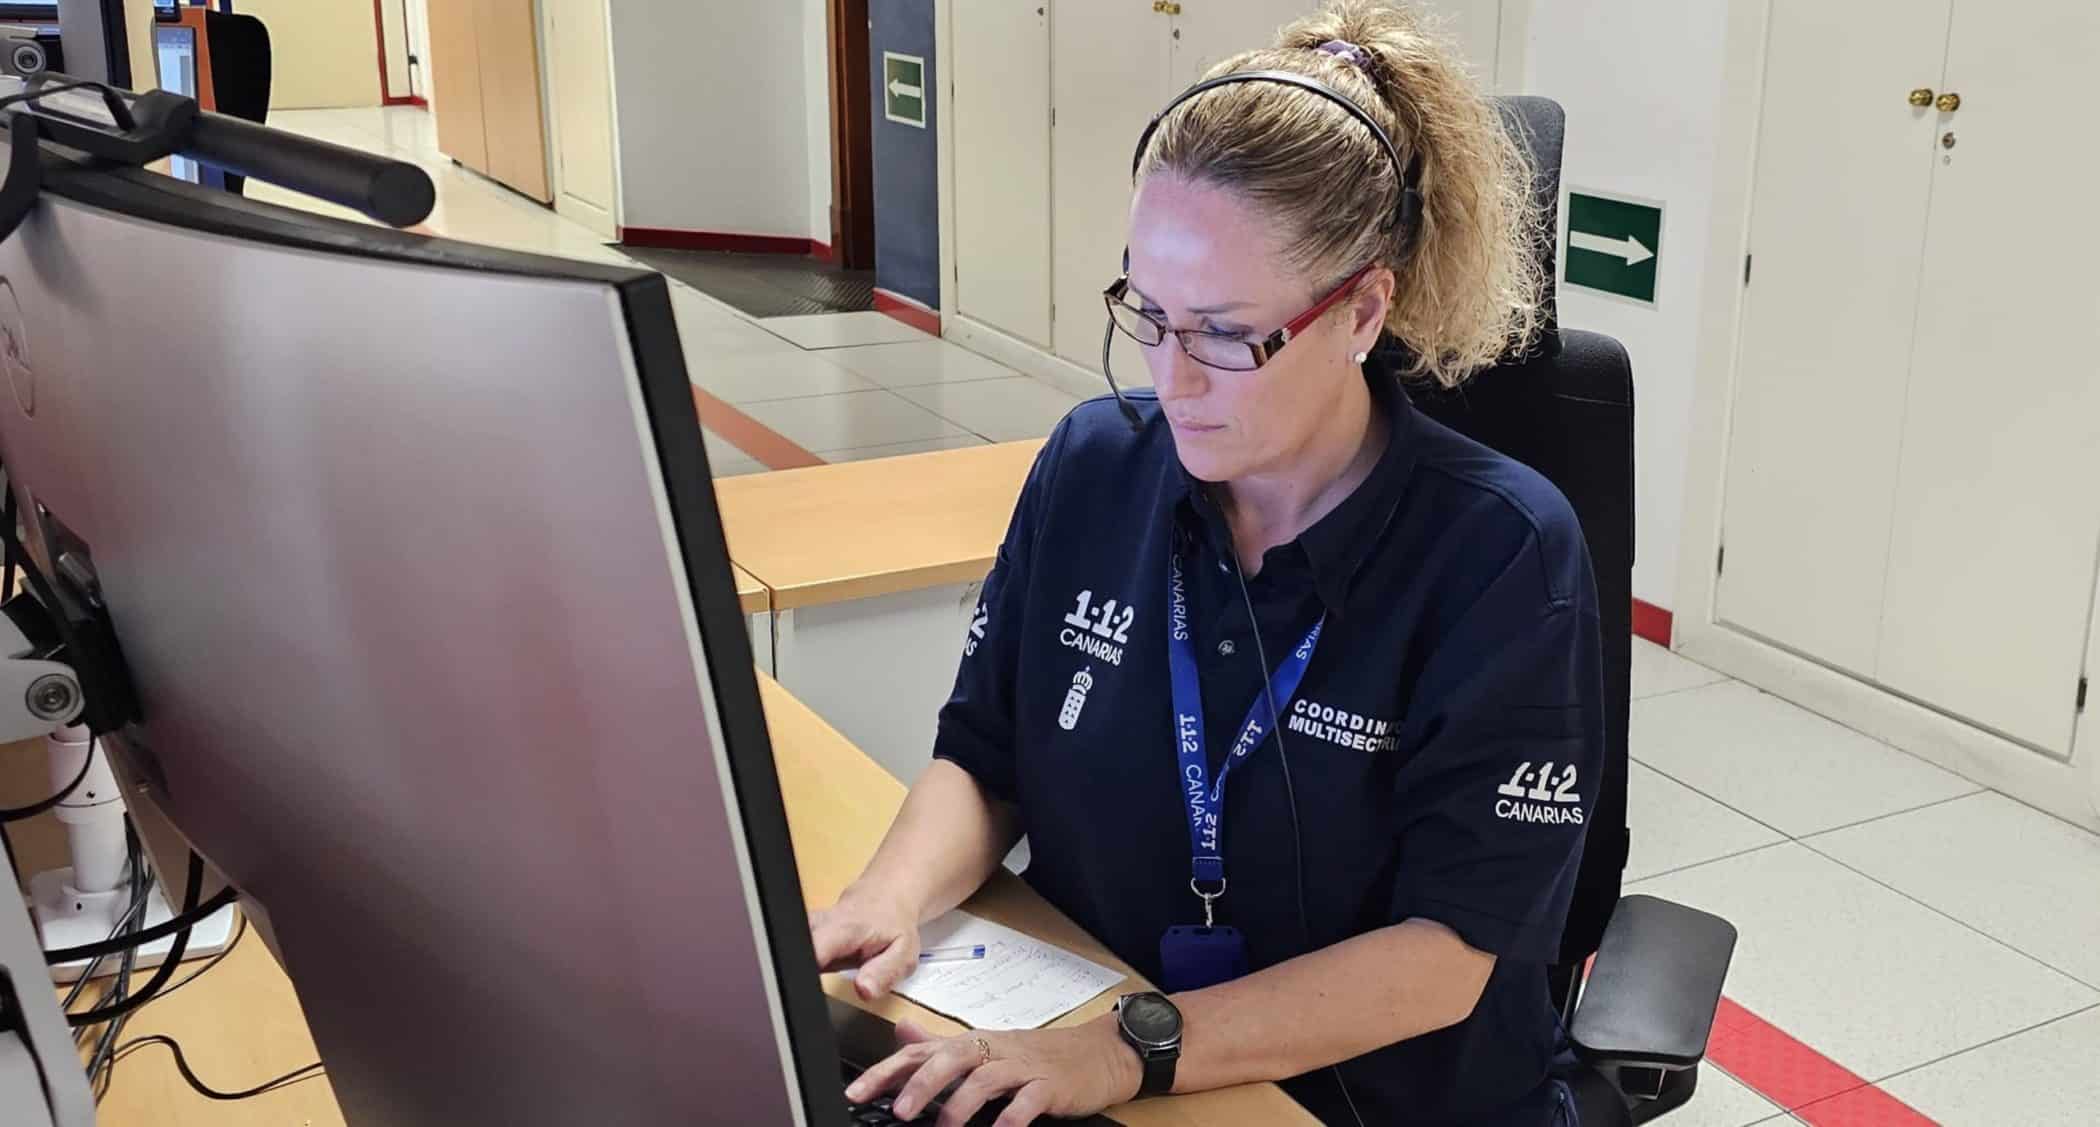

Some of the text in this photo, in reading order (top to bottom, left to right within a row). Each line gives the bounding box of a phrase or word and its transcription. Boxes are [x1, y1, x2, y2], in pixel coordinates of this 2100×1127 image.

[1172, 553, 1189, 641] CANARIAS
[1060, 628, 1123, 666] CANARIAS
[1495, 799, 1584, 824] CANARIAS
